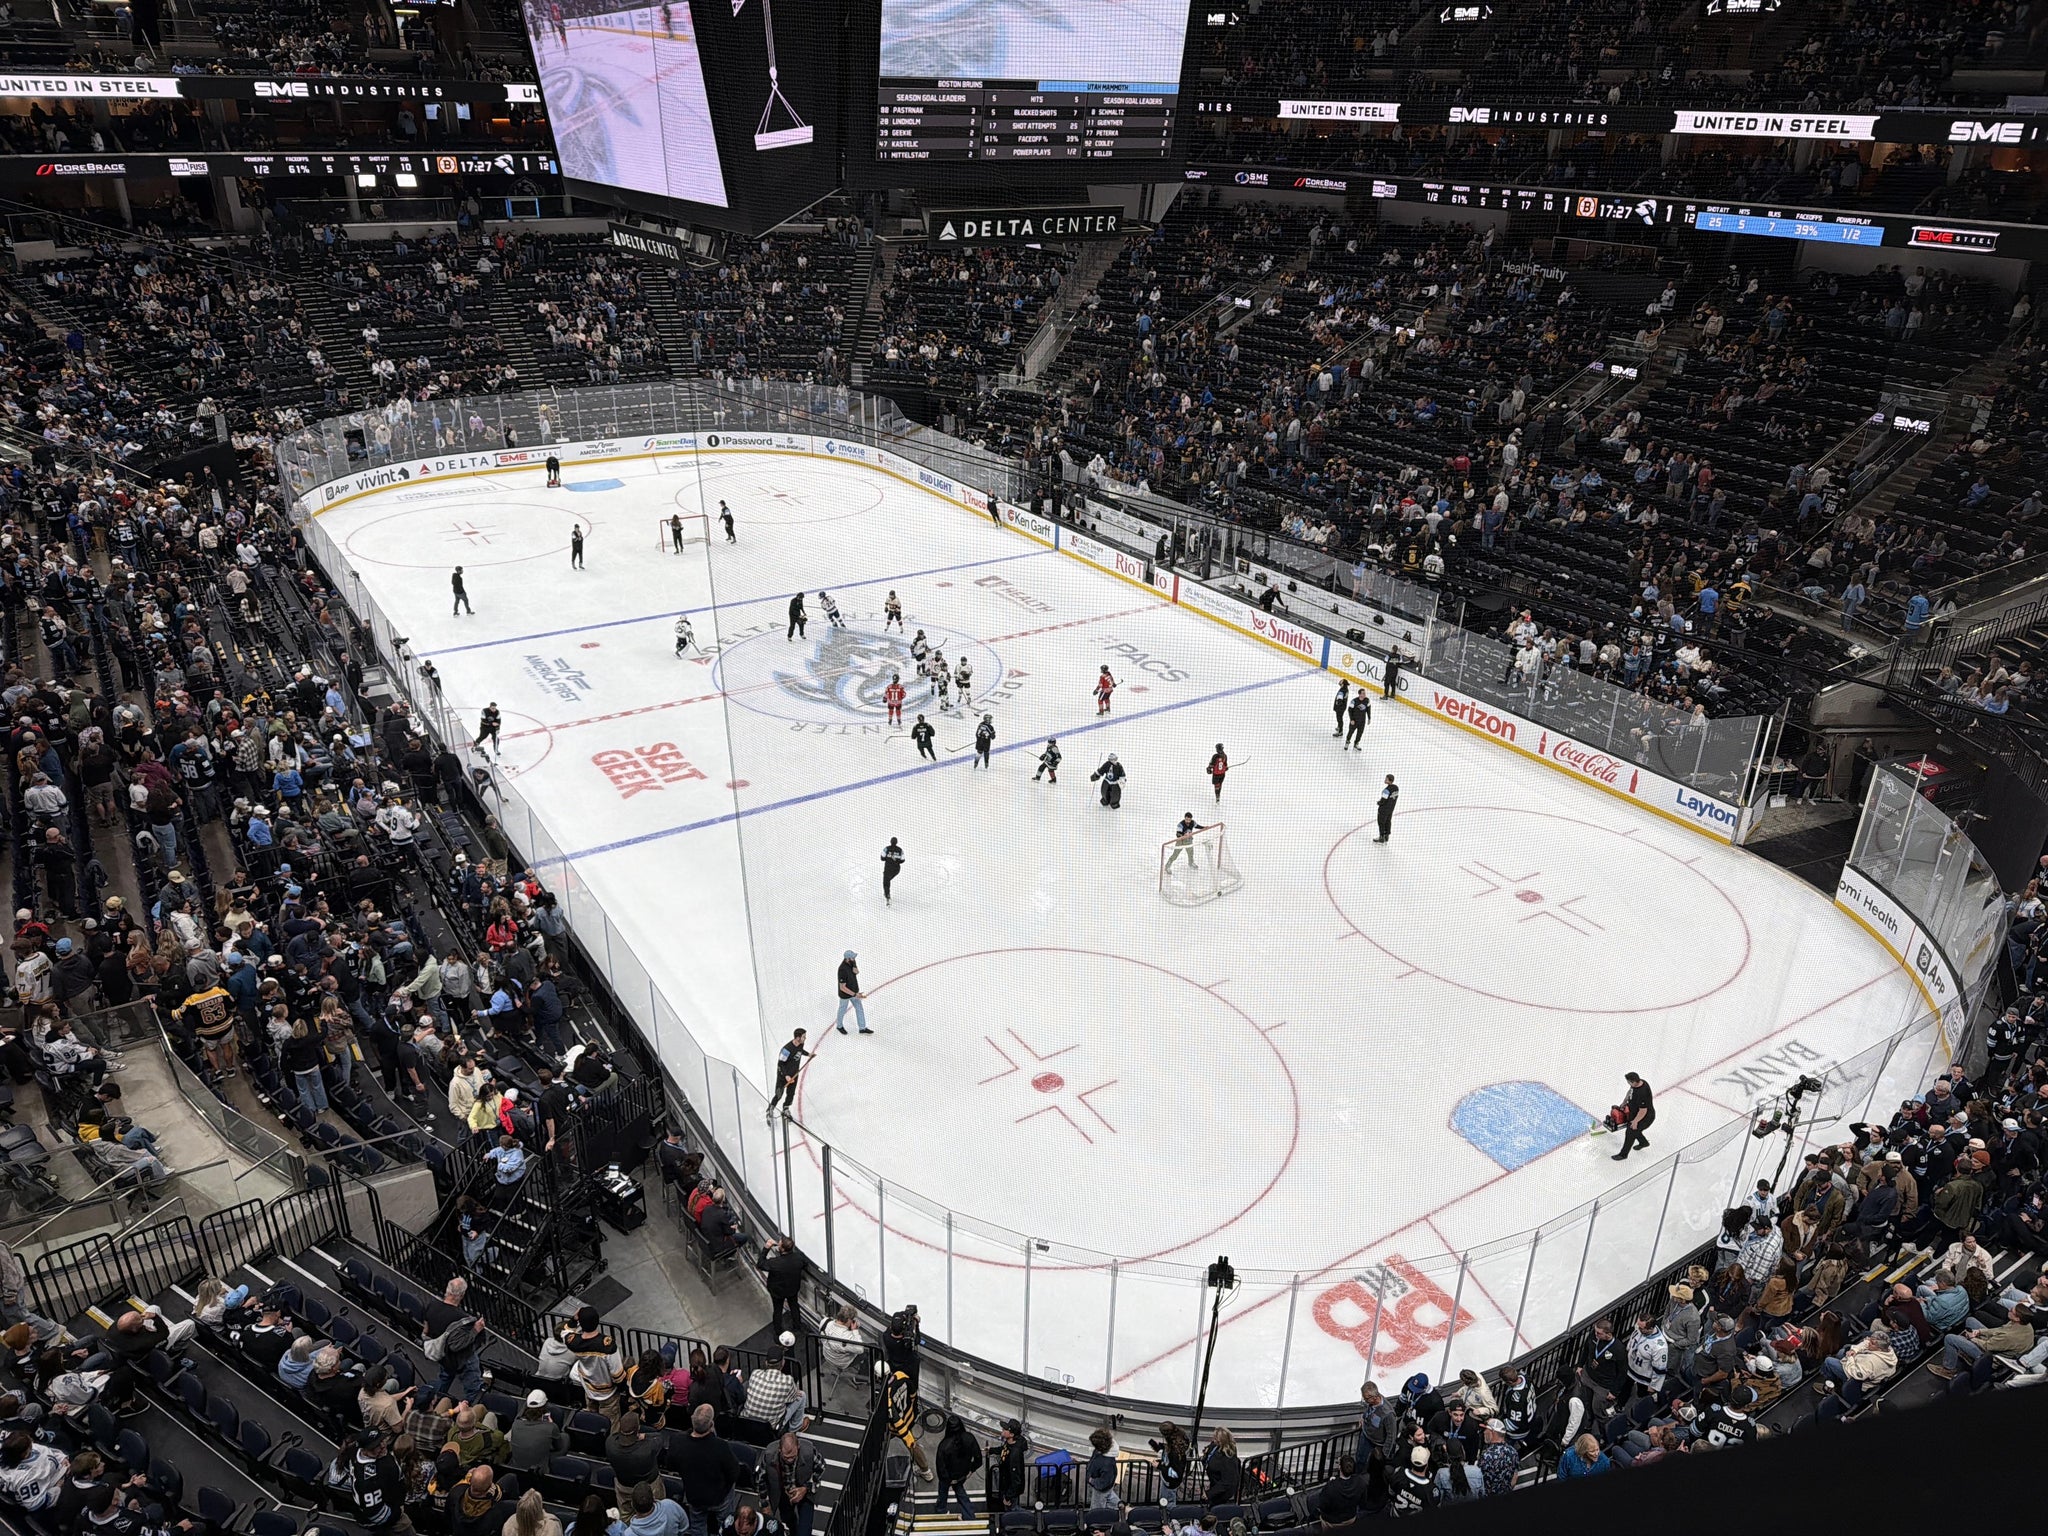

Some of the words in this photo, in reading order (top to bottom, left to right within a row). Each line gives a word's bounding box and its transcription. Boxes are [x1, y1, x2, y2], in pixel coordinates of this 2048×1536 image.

[1454, 8, 1479, 18] SME
[0, 80, 68, 91] UNITED
[75, 81, 93, 92] IN
[100, 82, 158, 93] STEEL
[254, 82, 309, 97] SME
[314, 86, 443, 96] INDUSTRIES
[938, 80, 961, 88] BOSTON
[962, 81, 983, 89] BRUINS
[1087, 82, 1101, 90] UTAH
[1102, 83, 1128, 91] MAMMOTH
[896, 94, 921, 102] SEASON
[1139, 97, 1162, 105] LEADERS
[893, 106, 923, 114] PASTRNAK
[1039, 109, 1057, 117] SHOTS
[1291, 105, 1332, 116] UNITED
[1335, 106, 1347, 116] IN
[1350, 106, 1385, 118] STEEL
[1448, 107, 1490, 124] SME
[1494, 111, 1608, 125] INDUSTRIES
[1027, 122, 1057, 130] ATTEMPTS
[1069, 122, 1078, 130] 25
[1693, 116, 1758, 131] UNITED
[1764, 118, 1783, 132] IN
[1789, 119, 1851, 135] STEEL
[880, 129, 888, 137] 39
[891, 129, 912, 137] GEEKIE
[1095, 129, 1119, 137] PETERKA
[1948, 121, 2025, 143] SME
[891, 140, 918, 148] KASTELIC
[891, 151, 929, 159] MITTELSTADT
[1066, 148, 1077, 156] 1/2
[253, 165, 270, 174] 1/2
[288, 165, 310, 174] 61%
[326, 165, 333, 173] 5
[353, 165, 360, 174] 5
[376, 165, 386, 173] 17
[400, 163, 411, 171] 10
[422, 157, 429, 171] 1
[460, 161, 492, 172] 17:27
[521, 157, 529, 171] 1
[539, 162, 549, 170] 12
[1249, 173, 1268, 181] SME
[1427, 192, 1438, 202] 1/2
[1451, 195, 1467, 204] 61%
[1480, 196, 1486, 206] 5
[1502, 198, 1508, 208] 5
[1521, 200, 1531, 210] 17
[1543, 201, 1553, 211] 10
[1564, 196, 1570, 213] 1
[1600, 204, 1633, 219] 17:27
[1666, 205, 1672, 222] 1
[1796, 213, 1823, 221] FACEOFFS
[1684, 213, 1695, 223] 12
[1708, 217, 1722, 227] 25
[1836, 216, 1857, 224] POWER
[964, 219, 1034, 238] DELTA
[1042, 215, 1116, 234] CENTER
[1737, 219, 1745, 229] 5
[1768, 222, 1775, 232] 7
[1794, 224, 1818, 235] 39%
[1841, 229, 1861, 240] 1/2
[1918, 231, 1954, 243] SME
[1955, 236, 1992, 245] STEEL
[620, 232, 646, 251] DELTA
[646, 239, 680, 261] CENTER
[1501, 260, 1566, 282] HealthEquity
[1611, 365, 1638, 378] SME
[1893, 416, 1930, 432] SME
[656, 438, 697, 446] SameDay
[721, 436, 773, 446] 1Password
[580, 448, 605, 456] AMERICA
[838, 444, 866, 456] moxie
[500, 453, 528, 463] SME
[531, 450, 558, 459] STEEL
[435, 457, 489, 471] DELTA
[356, 468, 396, 491] vivint
[919, 470, 932, 485] BUD
[932, 475, 953, 494] LIGHT
[1014, 511, 1030, 528] Ken
[1030, 516, 1051, 538] Garff
[120, 530, 133, 541] 26
[1745, 542, 1759, 553] 70
[700, 621, 786, 655] DELTA
[1268, 618, 1313, 655] Smith's
[1108, 642, 1190, 683] PACS
[523, 655, 561, 684] AMERICA
[550, 682, 581, 702] FIRST
[1356, 660, 1409, 692] OKLD
[1433, 691, 1516, 742] verizon
[634, 741, 708, 784] SEAT
[182, 763, 198, 779] 98
[591, 749, 665, 800] GEEK
[1940, 781, 1970, 793] TOYOTA
[1676, 788, 1737, 827] Layton
[1839, 879, 1863, 902] omi
[1863, 895, 1899, 935] Health
[200, 1005, 227, 1025] 63
[63, 1049, 77, 1060] 92
[1713, 1039, 1825, 1097] BANK
[1510, 1410, 1522, 1422] 92
[1717, 1421, 1745, 1438] COOLEY
[20, 1481, 41, 1501] 98
[363, 1489, 383, 1508] 92
